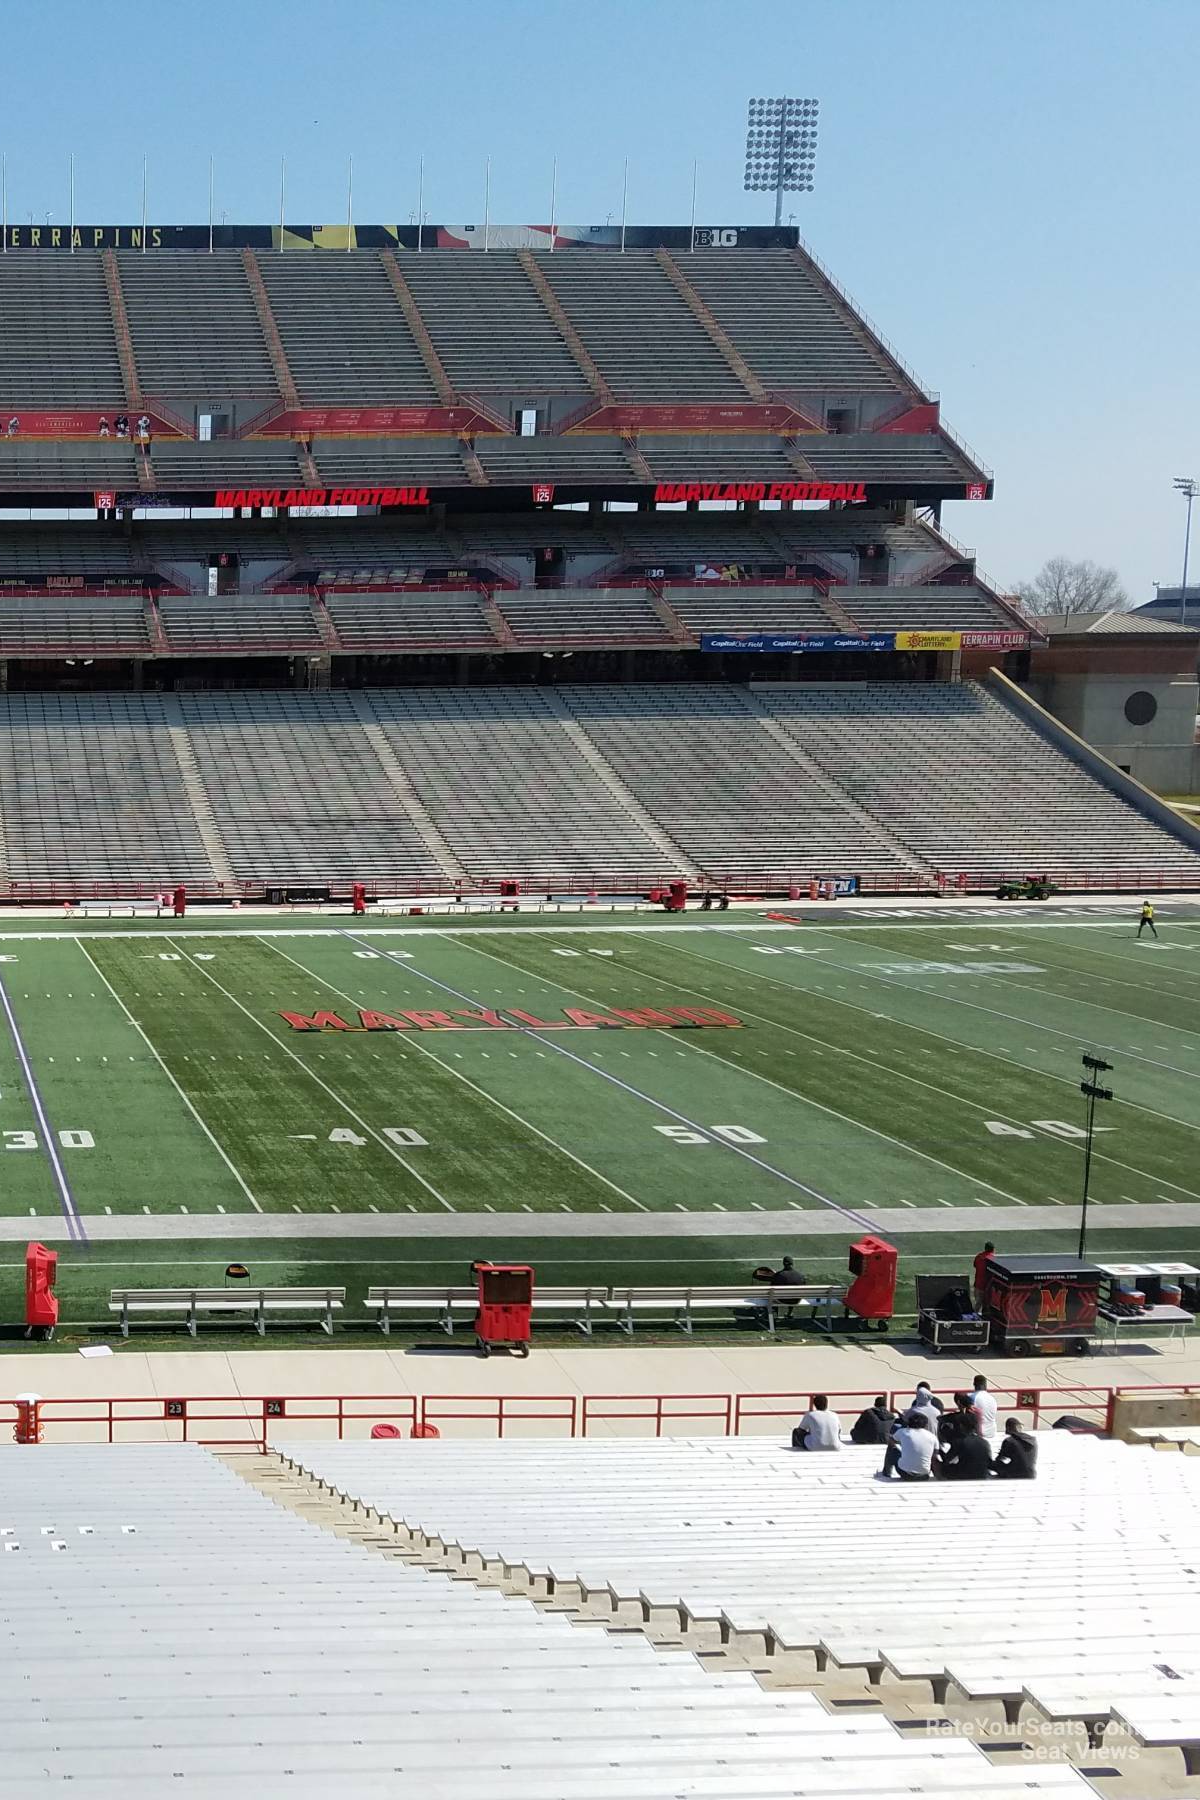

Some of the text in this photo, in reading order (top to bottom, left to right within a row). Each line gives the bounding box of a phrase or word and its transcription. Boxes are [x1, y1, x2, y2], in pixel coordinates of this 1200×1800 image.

[655, 482, 867, 501] MARYLAND FOOTBALL
[970, 490, 983, 499] 125
[214, 487, 430, 507] MARYLAND FOOTBALL
[536, 492, 550, 502] 125
[98, 498, 111, 508] 125
[962, 635, 1001, 645] TERRAPIN
[275, 1007, 744, 1029] MARYLAND
[1038, 1289, 1068, 1321] M
[169, 1403, 182, 1414] 23
[267, 1403, 281, 1413] 24
